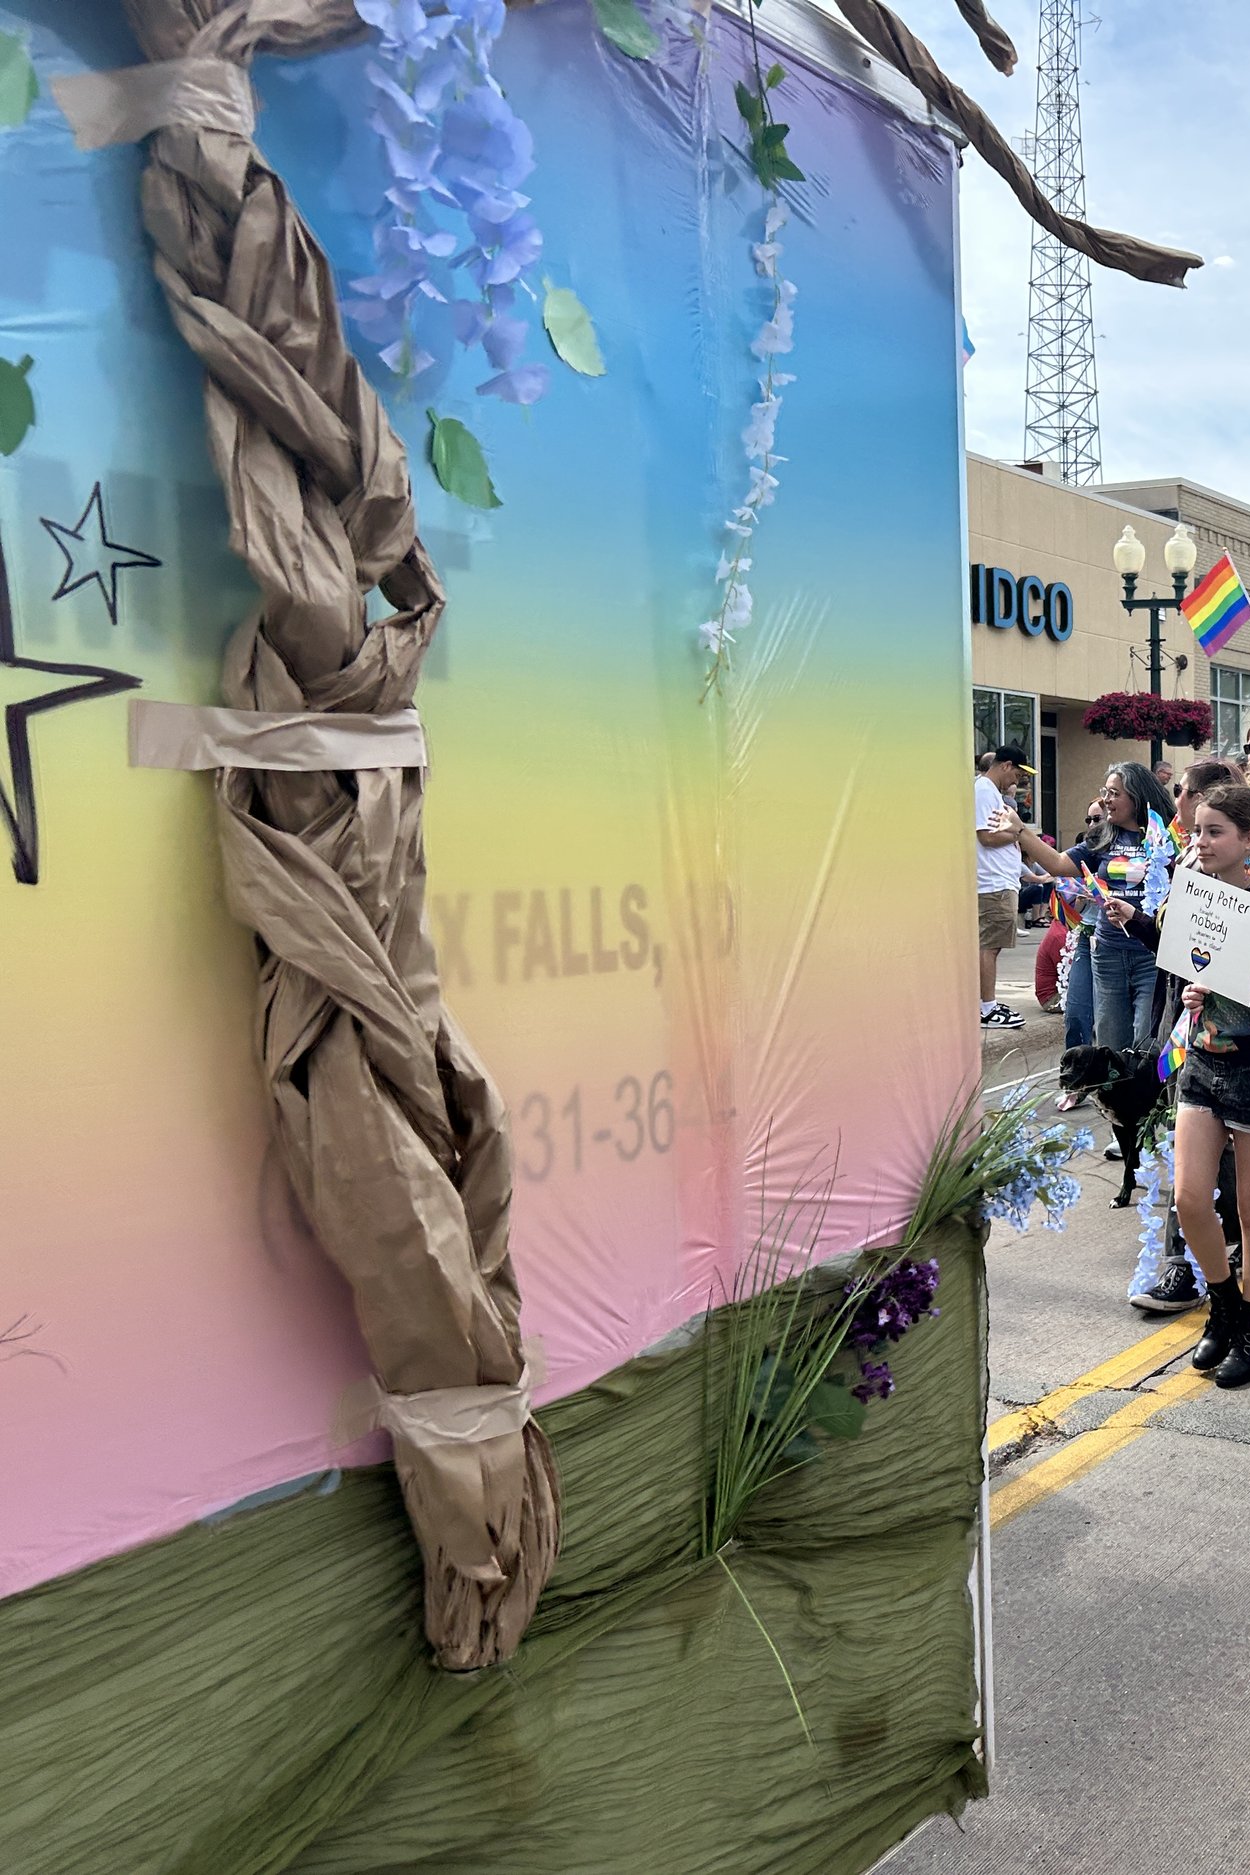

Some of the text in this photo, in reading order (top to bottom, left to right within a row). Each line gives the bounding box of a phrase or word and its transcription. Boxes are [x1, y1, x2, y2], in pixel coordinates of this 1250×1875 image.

[971, 563, 1074, 643] IDCO
[1185, 880, 1250, 914] Harry Potter
[493, 883, 665, 988] FALLS,
[1190, 912, 1228, 943] nobody
